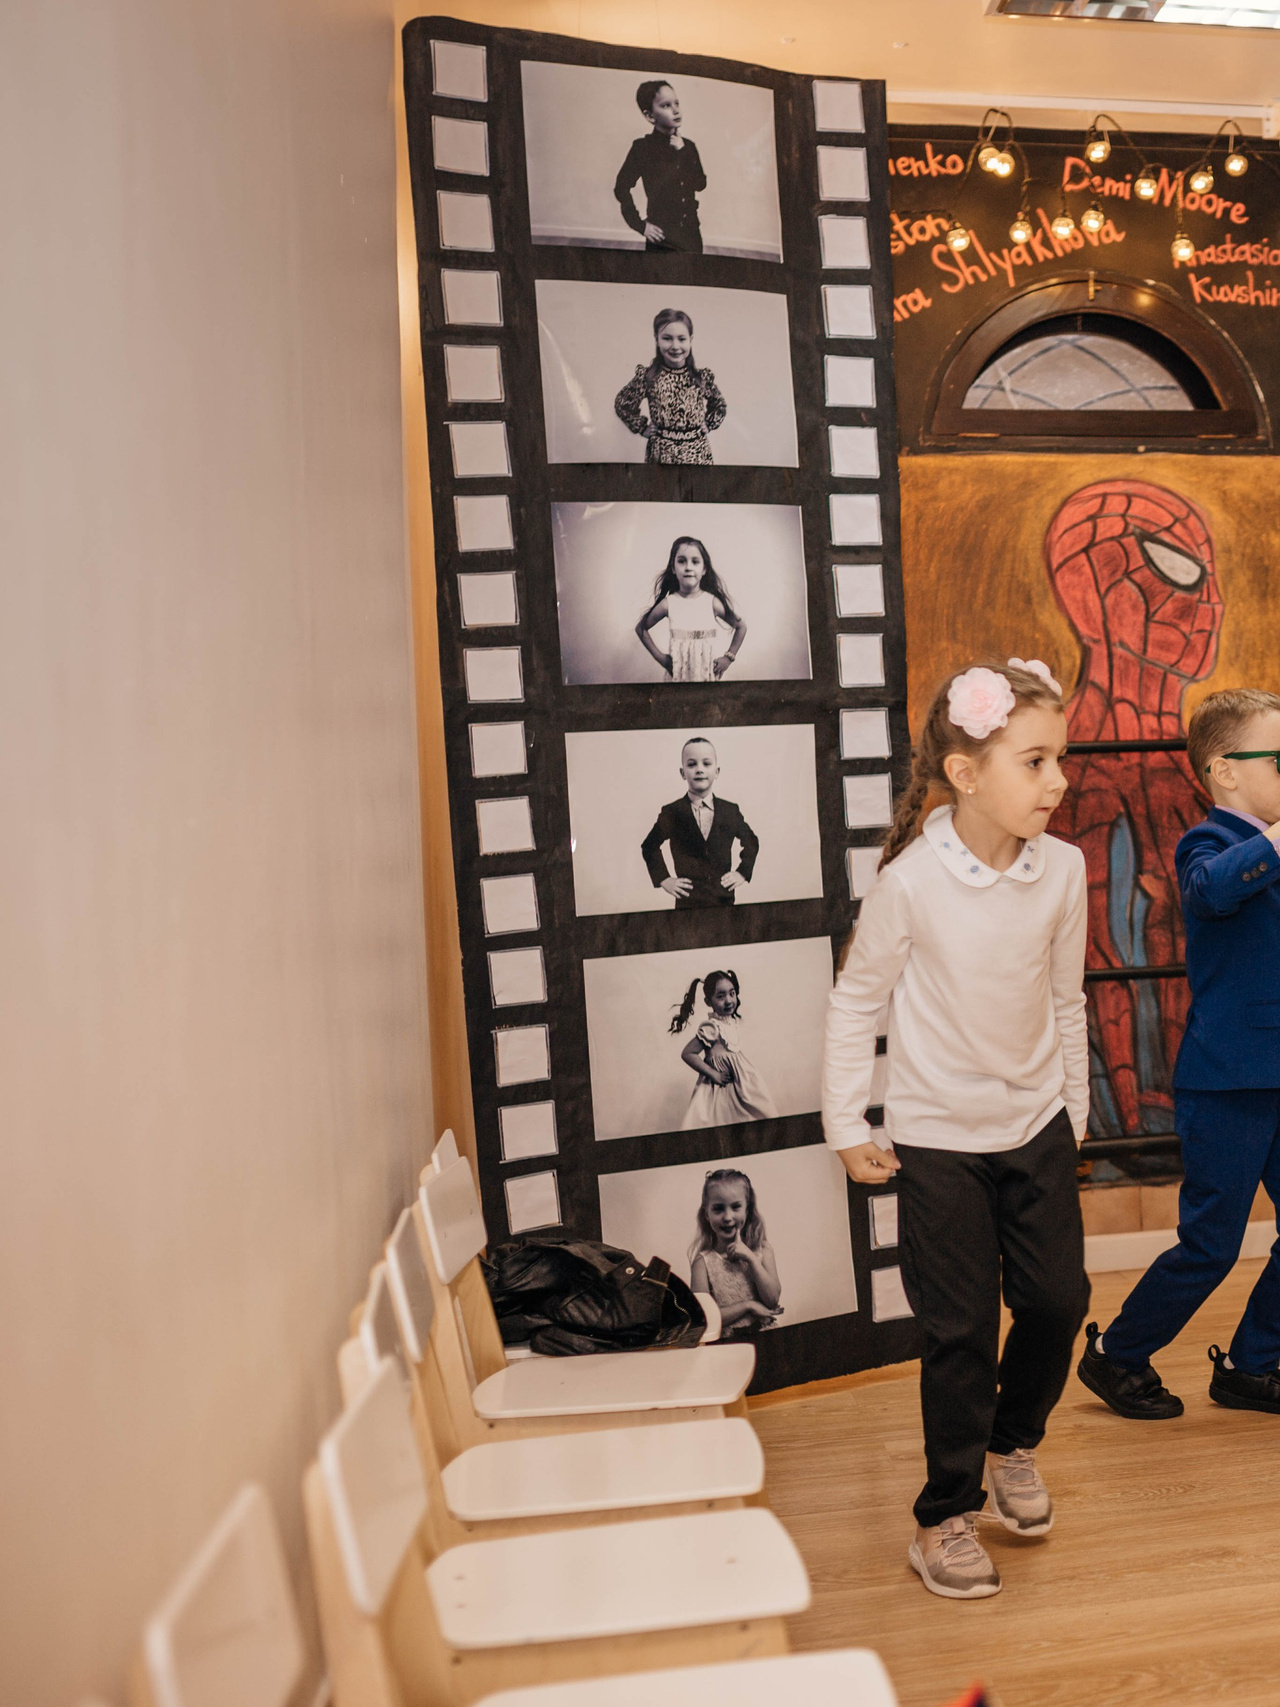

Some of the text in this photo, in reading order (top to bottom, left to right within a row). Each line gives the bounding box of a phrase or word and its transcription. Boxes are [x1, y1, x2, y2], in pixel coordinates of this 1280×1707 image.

[1062, 156, 1249, 224] Demi Moore
[931, 207, 1126, 293] Shlyakhova
